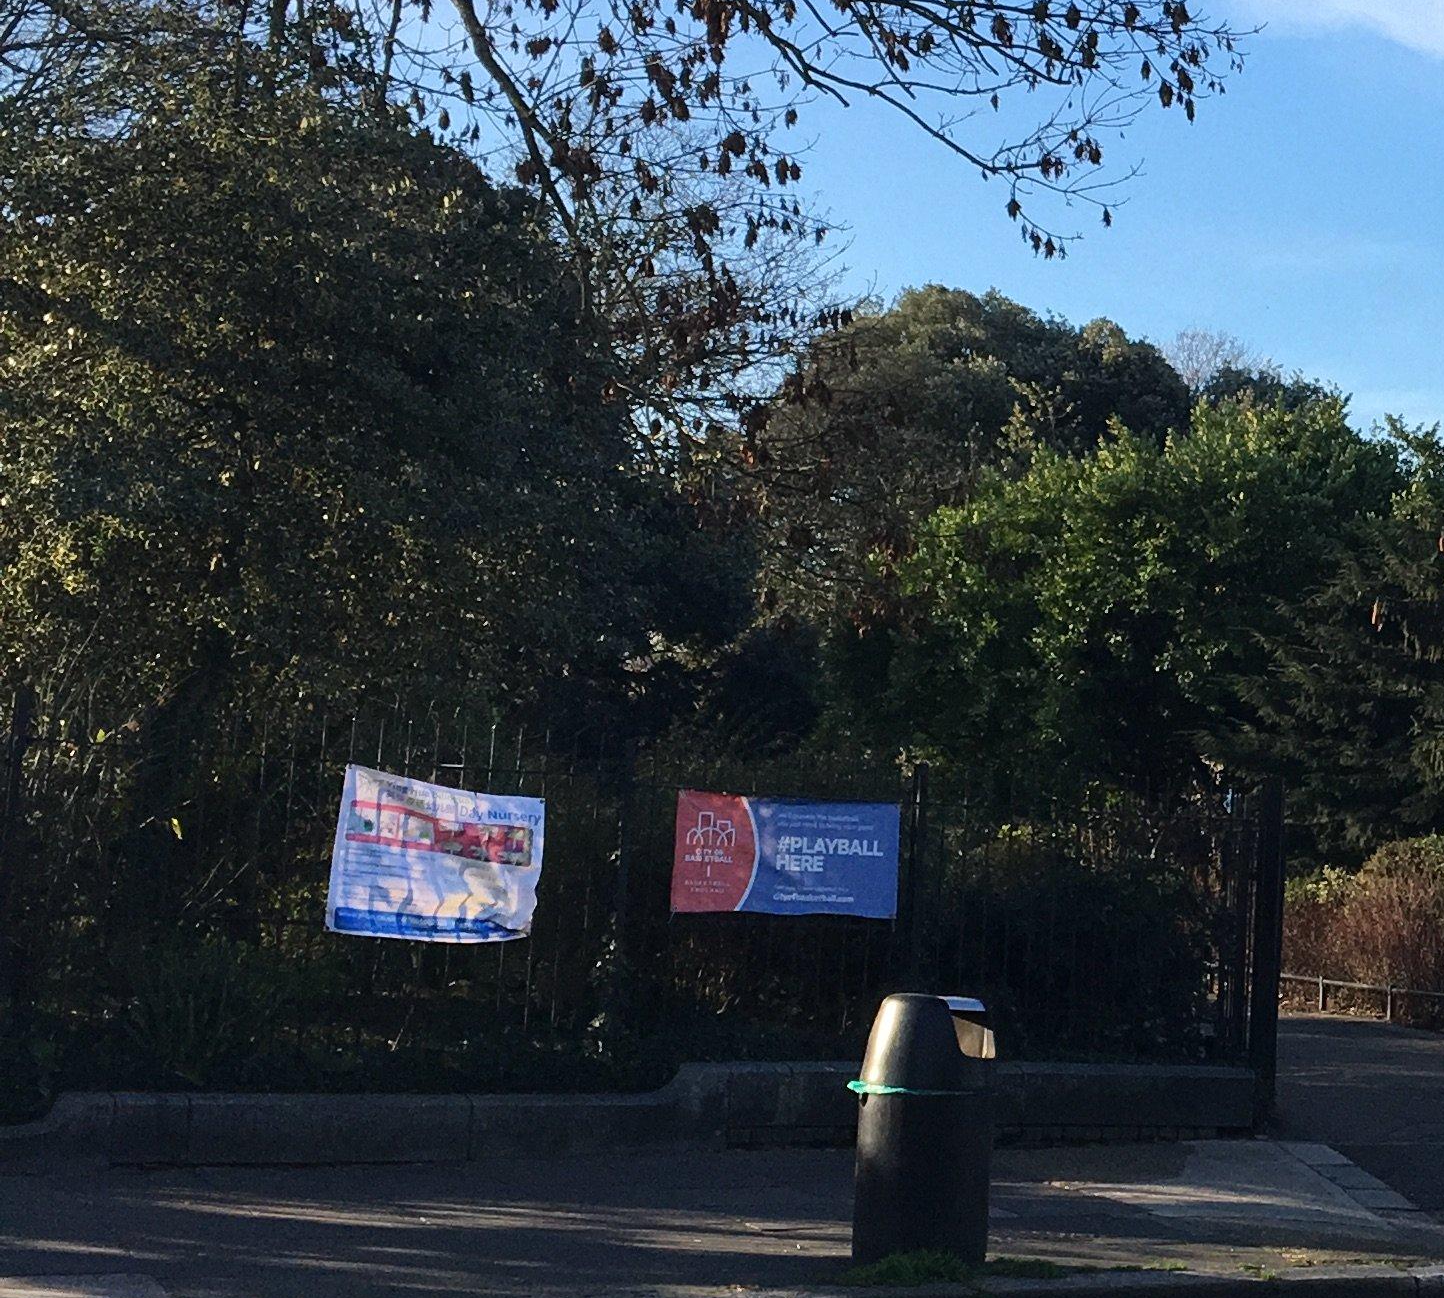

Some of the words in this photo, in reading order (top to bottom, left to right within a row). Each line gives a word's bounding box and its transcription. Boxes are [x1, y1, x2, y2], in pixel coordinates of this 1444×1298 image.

[460, 806, 483, 822] Day
[487, 809, 542, 826] Nursery
[778, 836, 884, 857] #PLAYBALL
[775, 854, 825, 872] HERE
